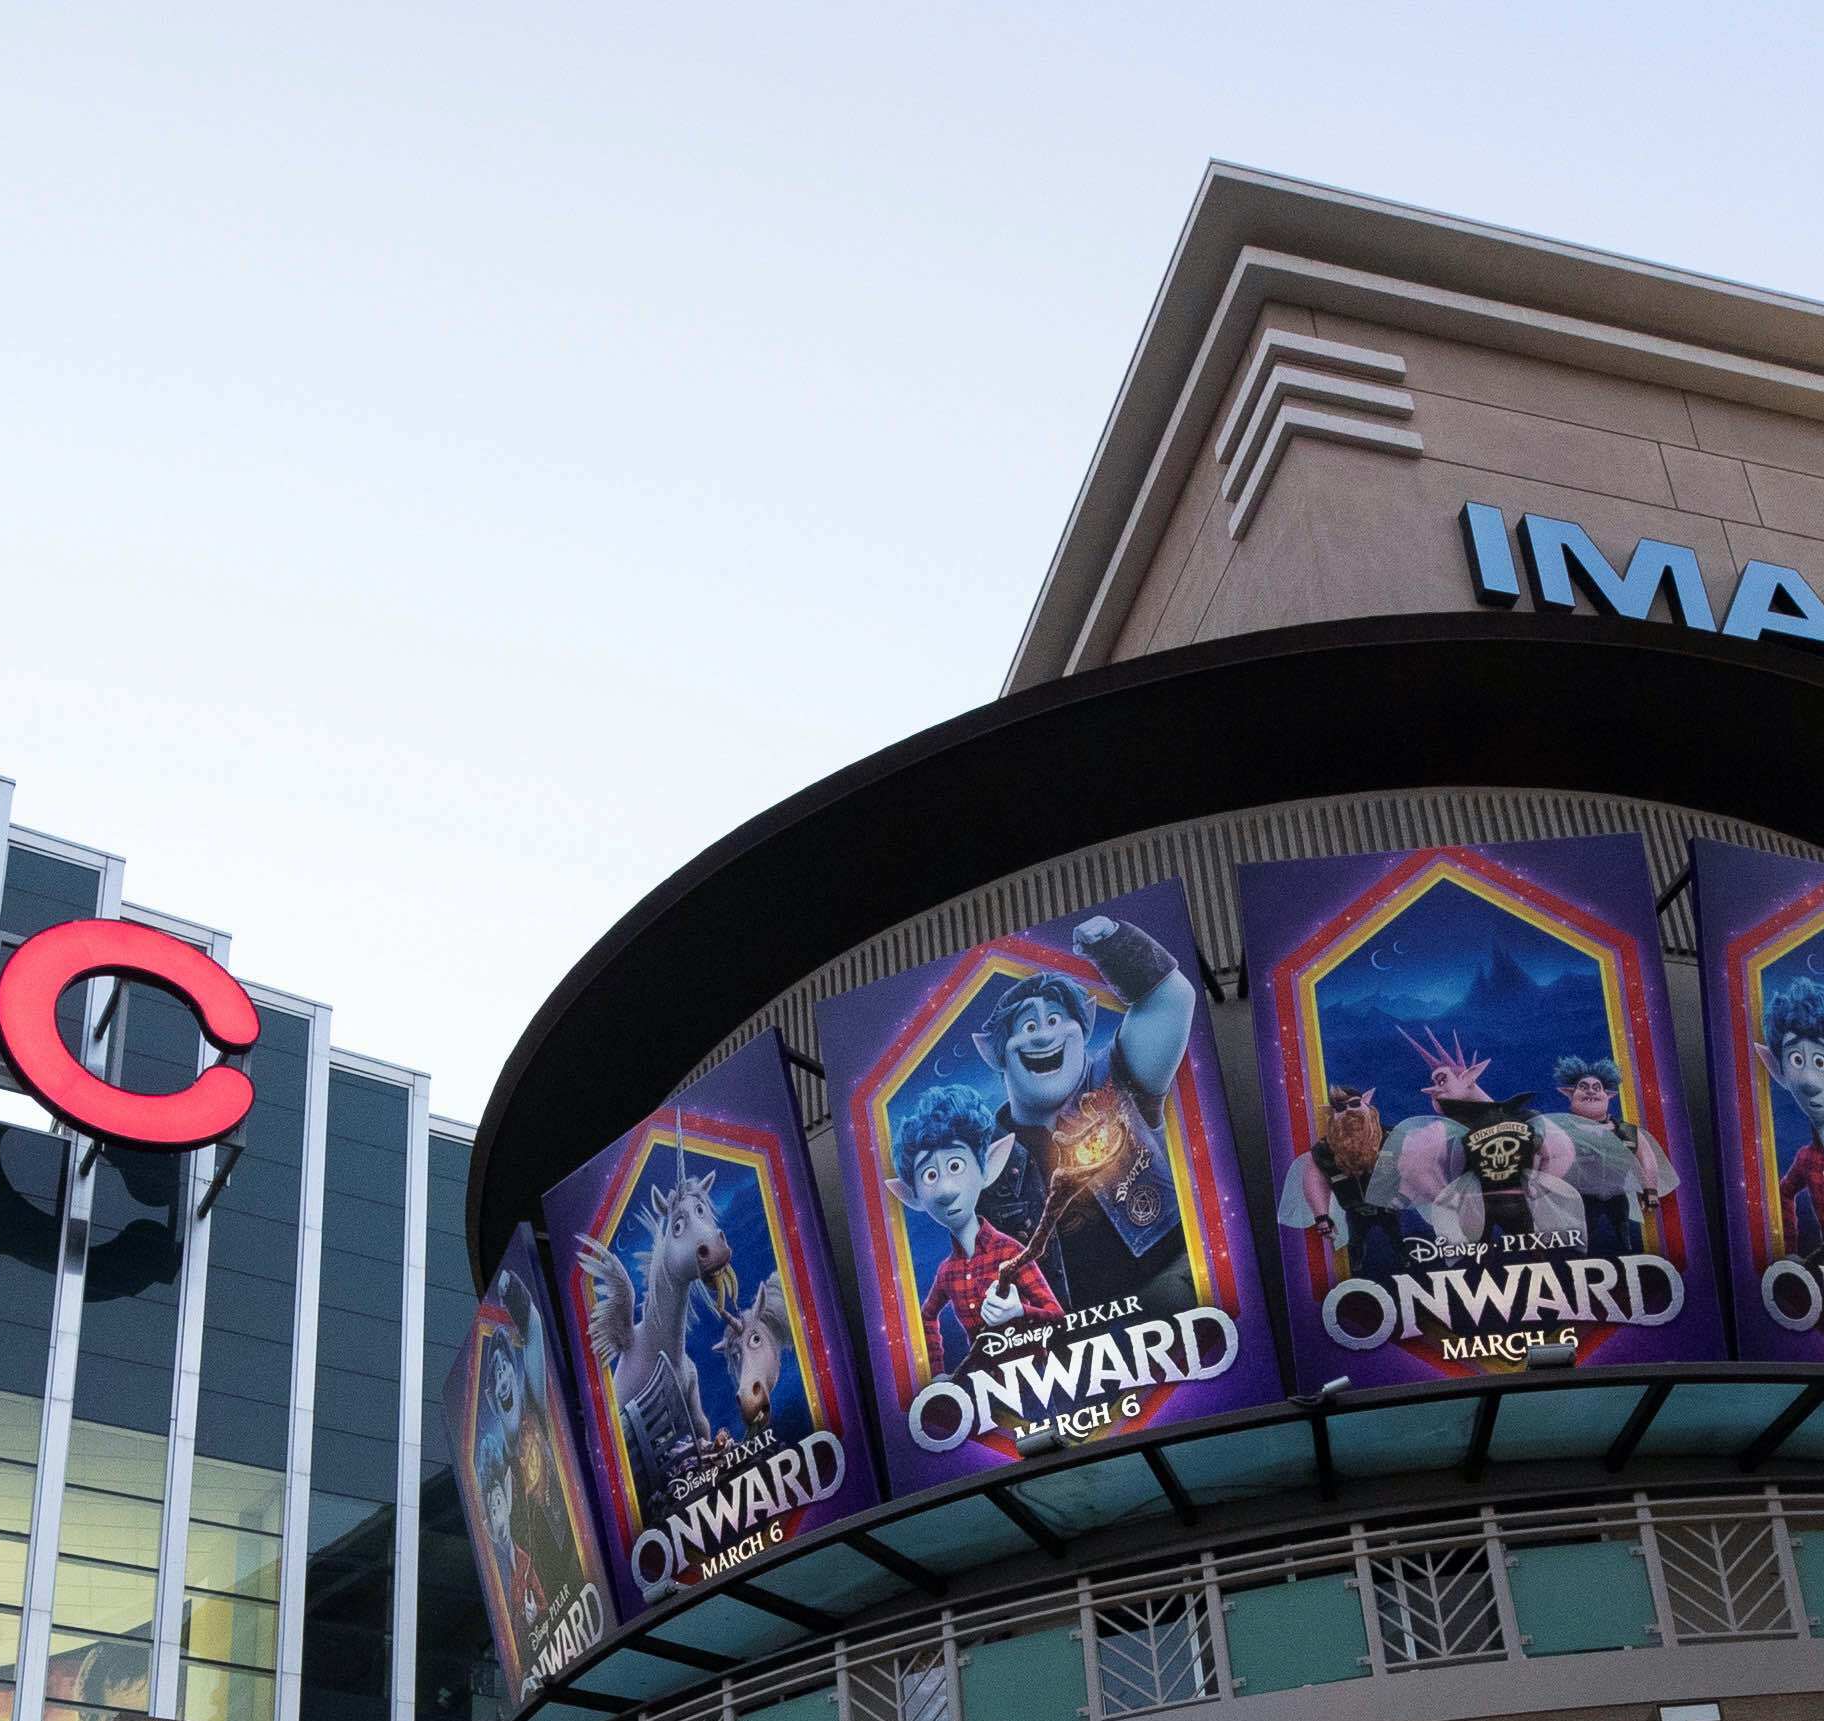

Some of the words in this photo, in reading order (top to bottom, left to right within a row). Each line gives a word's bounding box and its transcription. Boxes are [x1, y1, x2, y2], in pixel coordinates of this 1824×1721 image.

[1502, 1229, 1585, 1253] PIXAR
[1064, 1295, 1144, 1333] PIXAR
[1321, 1254, 1685, 1351] ONWARD
[1441, 1330, 1545, 1361] MARCH
[908, 1305, 1239, 1454] ONWARD
[1121, 1393, 1141, 1418] 6
[724, 1428, 778, 1469] PIXAR
[630, 1430, 846, 1601] ONWARD
[700, 1530, 764, 1580] MARCH
[769, 1520, 785, 1544] 6
